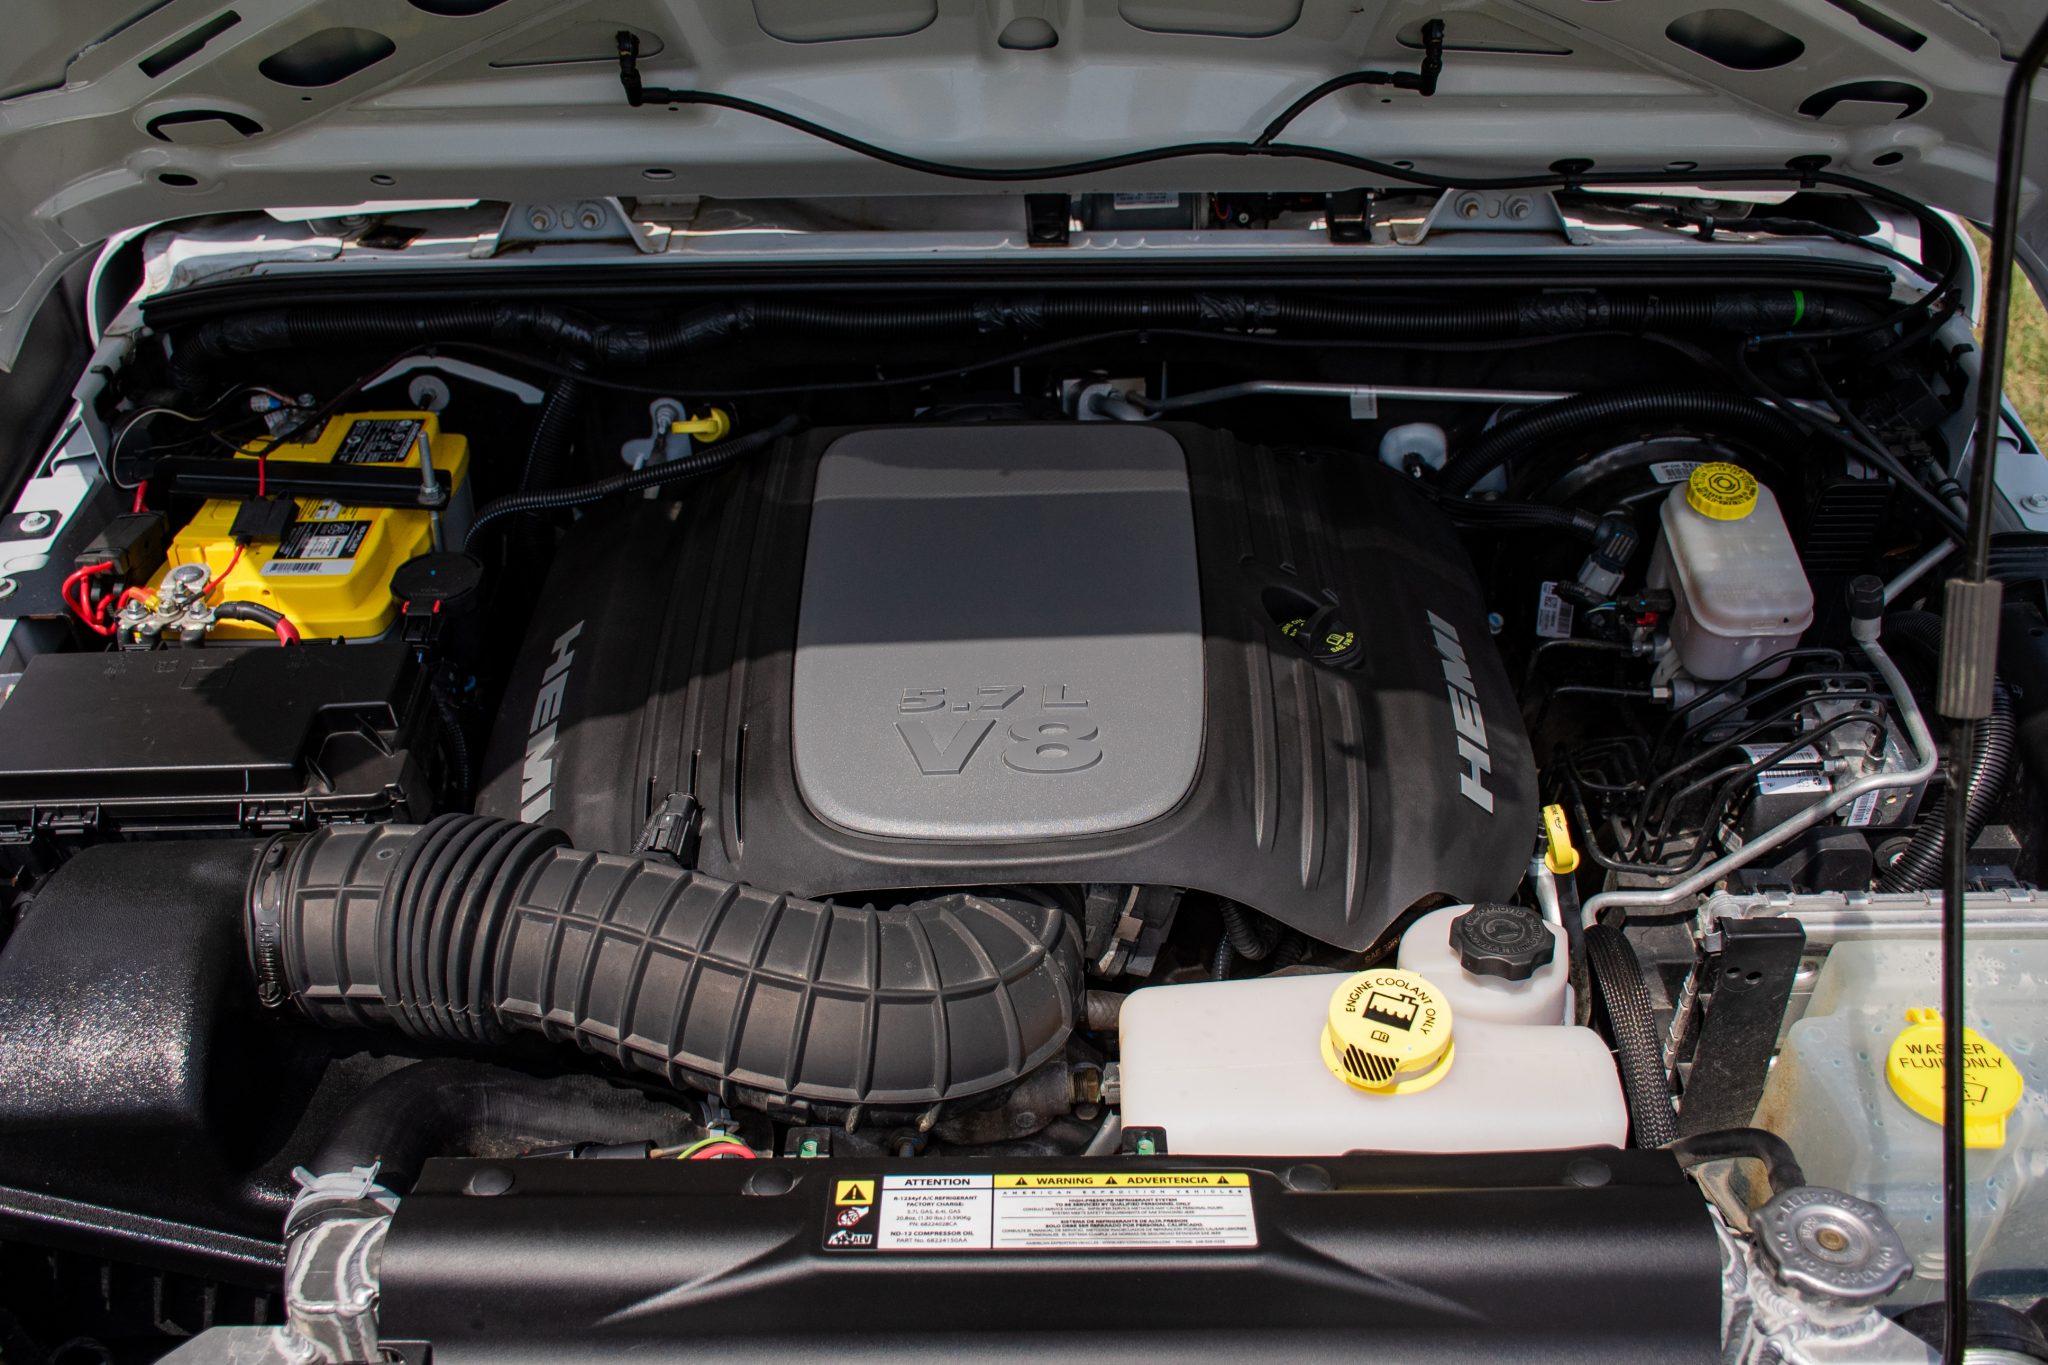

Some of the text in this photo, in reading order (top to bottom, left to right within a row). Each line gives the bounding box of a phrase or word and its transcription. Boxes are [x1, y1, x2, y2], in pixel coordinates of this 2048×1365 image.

[898, 684, 1090, 713] 5.7L
[1426, 609, 1493, 814] HEMI
[521, 620, 584, 824] HEMI
[893, 717, 1103, 776] V8
[1345, 977, 1436, 1035] ENGINE COOLANT ONLY
[1905, 1043, 1986, 1054] WASER
[904, 1178, 971, 1186] ATTENTION
[1036, 1176, 1209, 1185] WARNING ADVERTENCIA
